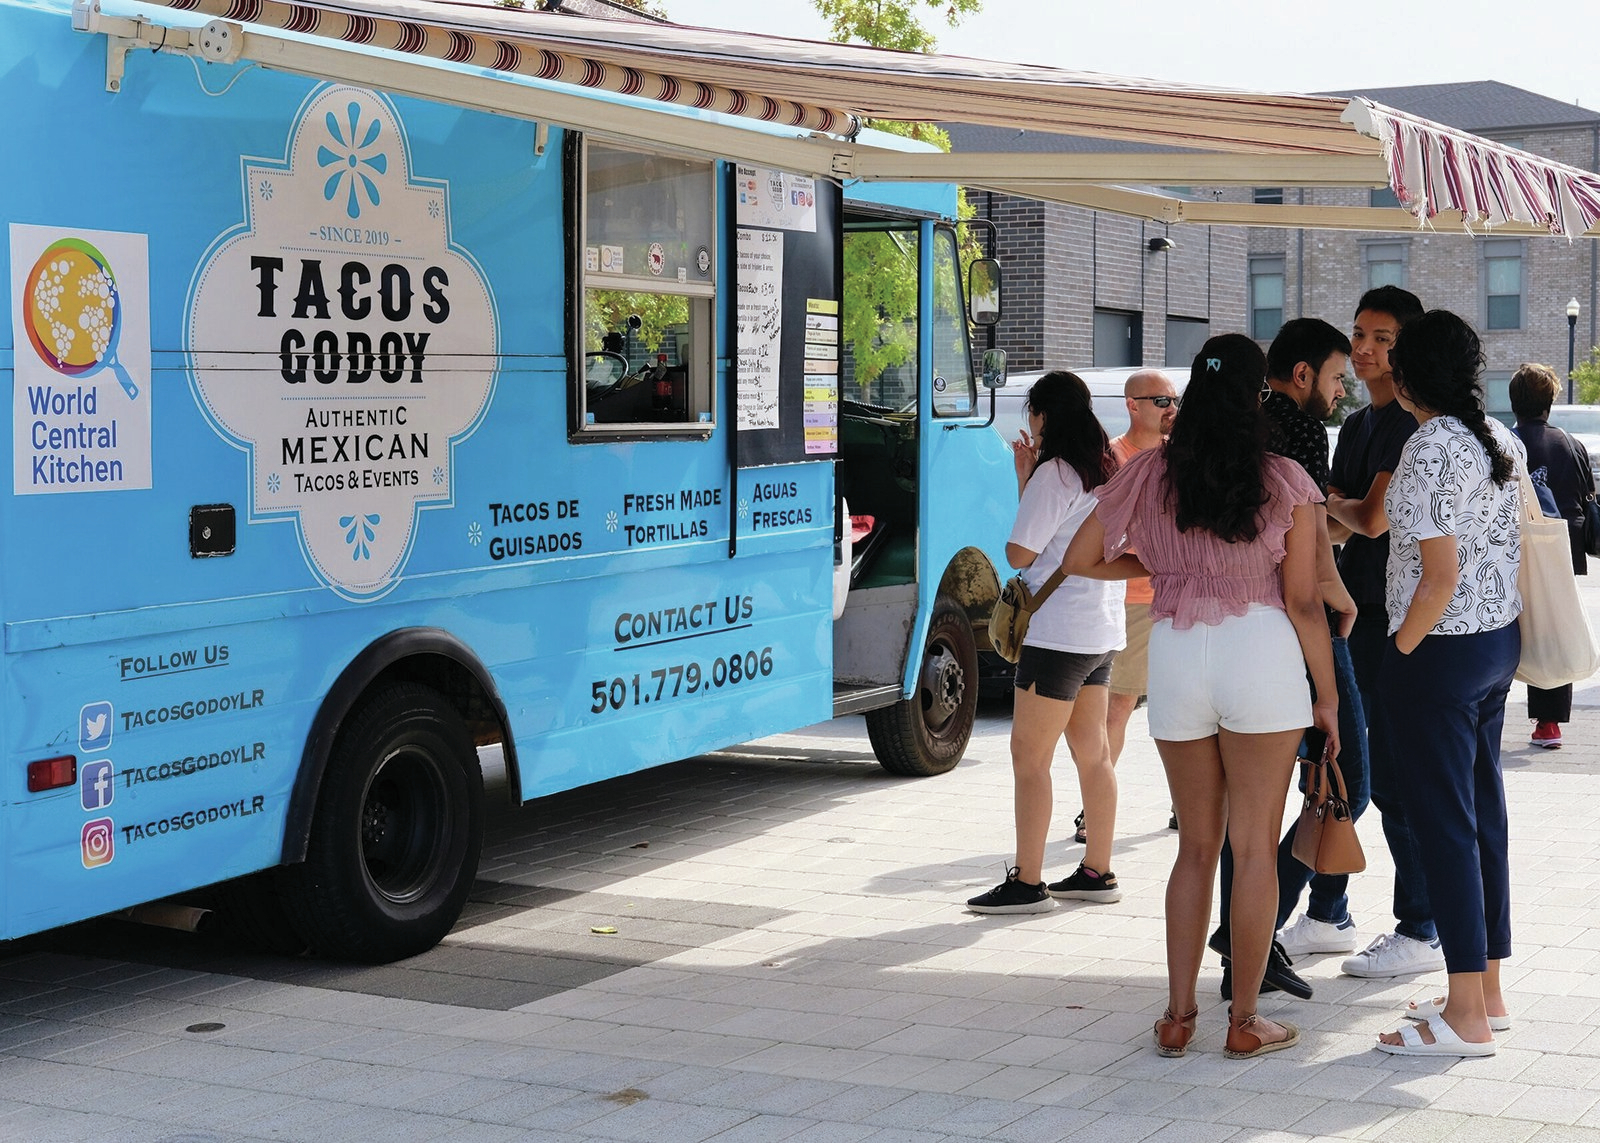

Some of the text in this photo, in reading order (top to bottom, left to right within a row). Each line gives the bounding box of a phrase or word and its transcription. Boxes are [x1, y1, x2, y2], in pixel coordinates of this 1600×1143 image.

[319, 226, 390, 246] SINCE 2019
[250, 255, 450, 324] TACOS
[279, 328, 431, 384] GODOY
[28, 386, 96, 415] World
[305, 406, 407, 428] AUTHENTIC
[32, 420, 117, 450] Central
[281, 433, 429, 465] MEXICAN
[32, 454, 123, 484] Kitchen
[294, 469, 419, 493] TACOS & EVENTS
[624, 488, 722, 516] FRESH MADE
[753, 482, 798, 503] AGUAS
[489, 500, 580, 526] TACOS DE
[753, 508, 812, 532] FRESCAS
[489, 531, 583, 560] GUISADOS
[624, 520, 708, 546] TORTILLAS
[614, 595, 753, 643] CONTACT US
[120, 645, 229, 678] FOLLOW US
[590, 647, 774, 714] 501.779.0806
[121, 689, 265, 731] TACOSGODOYLR
[121, 742, 265, 788] TACOSGODOYLR
[121, 795, 264, 844] TACOSGODOYLR
